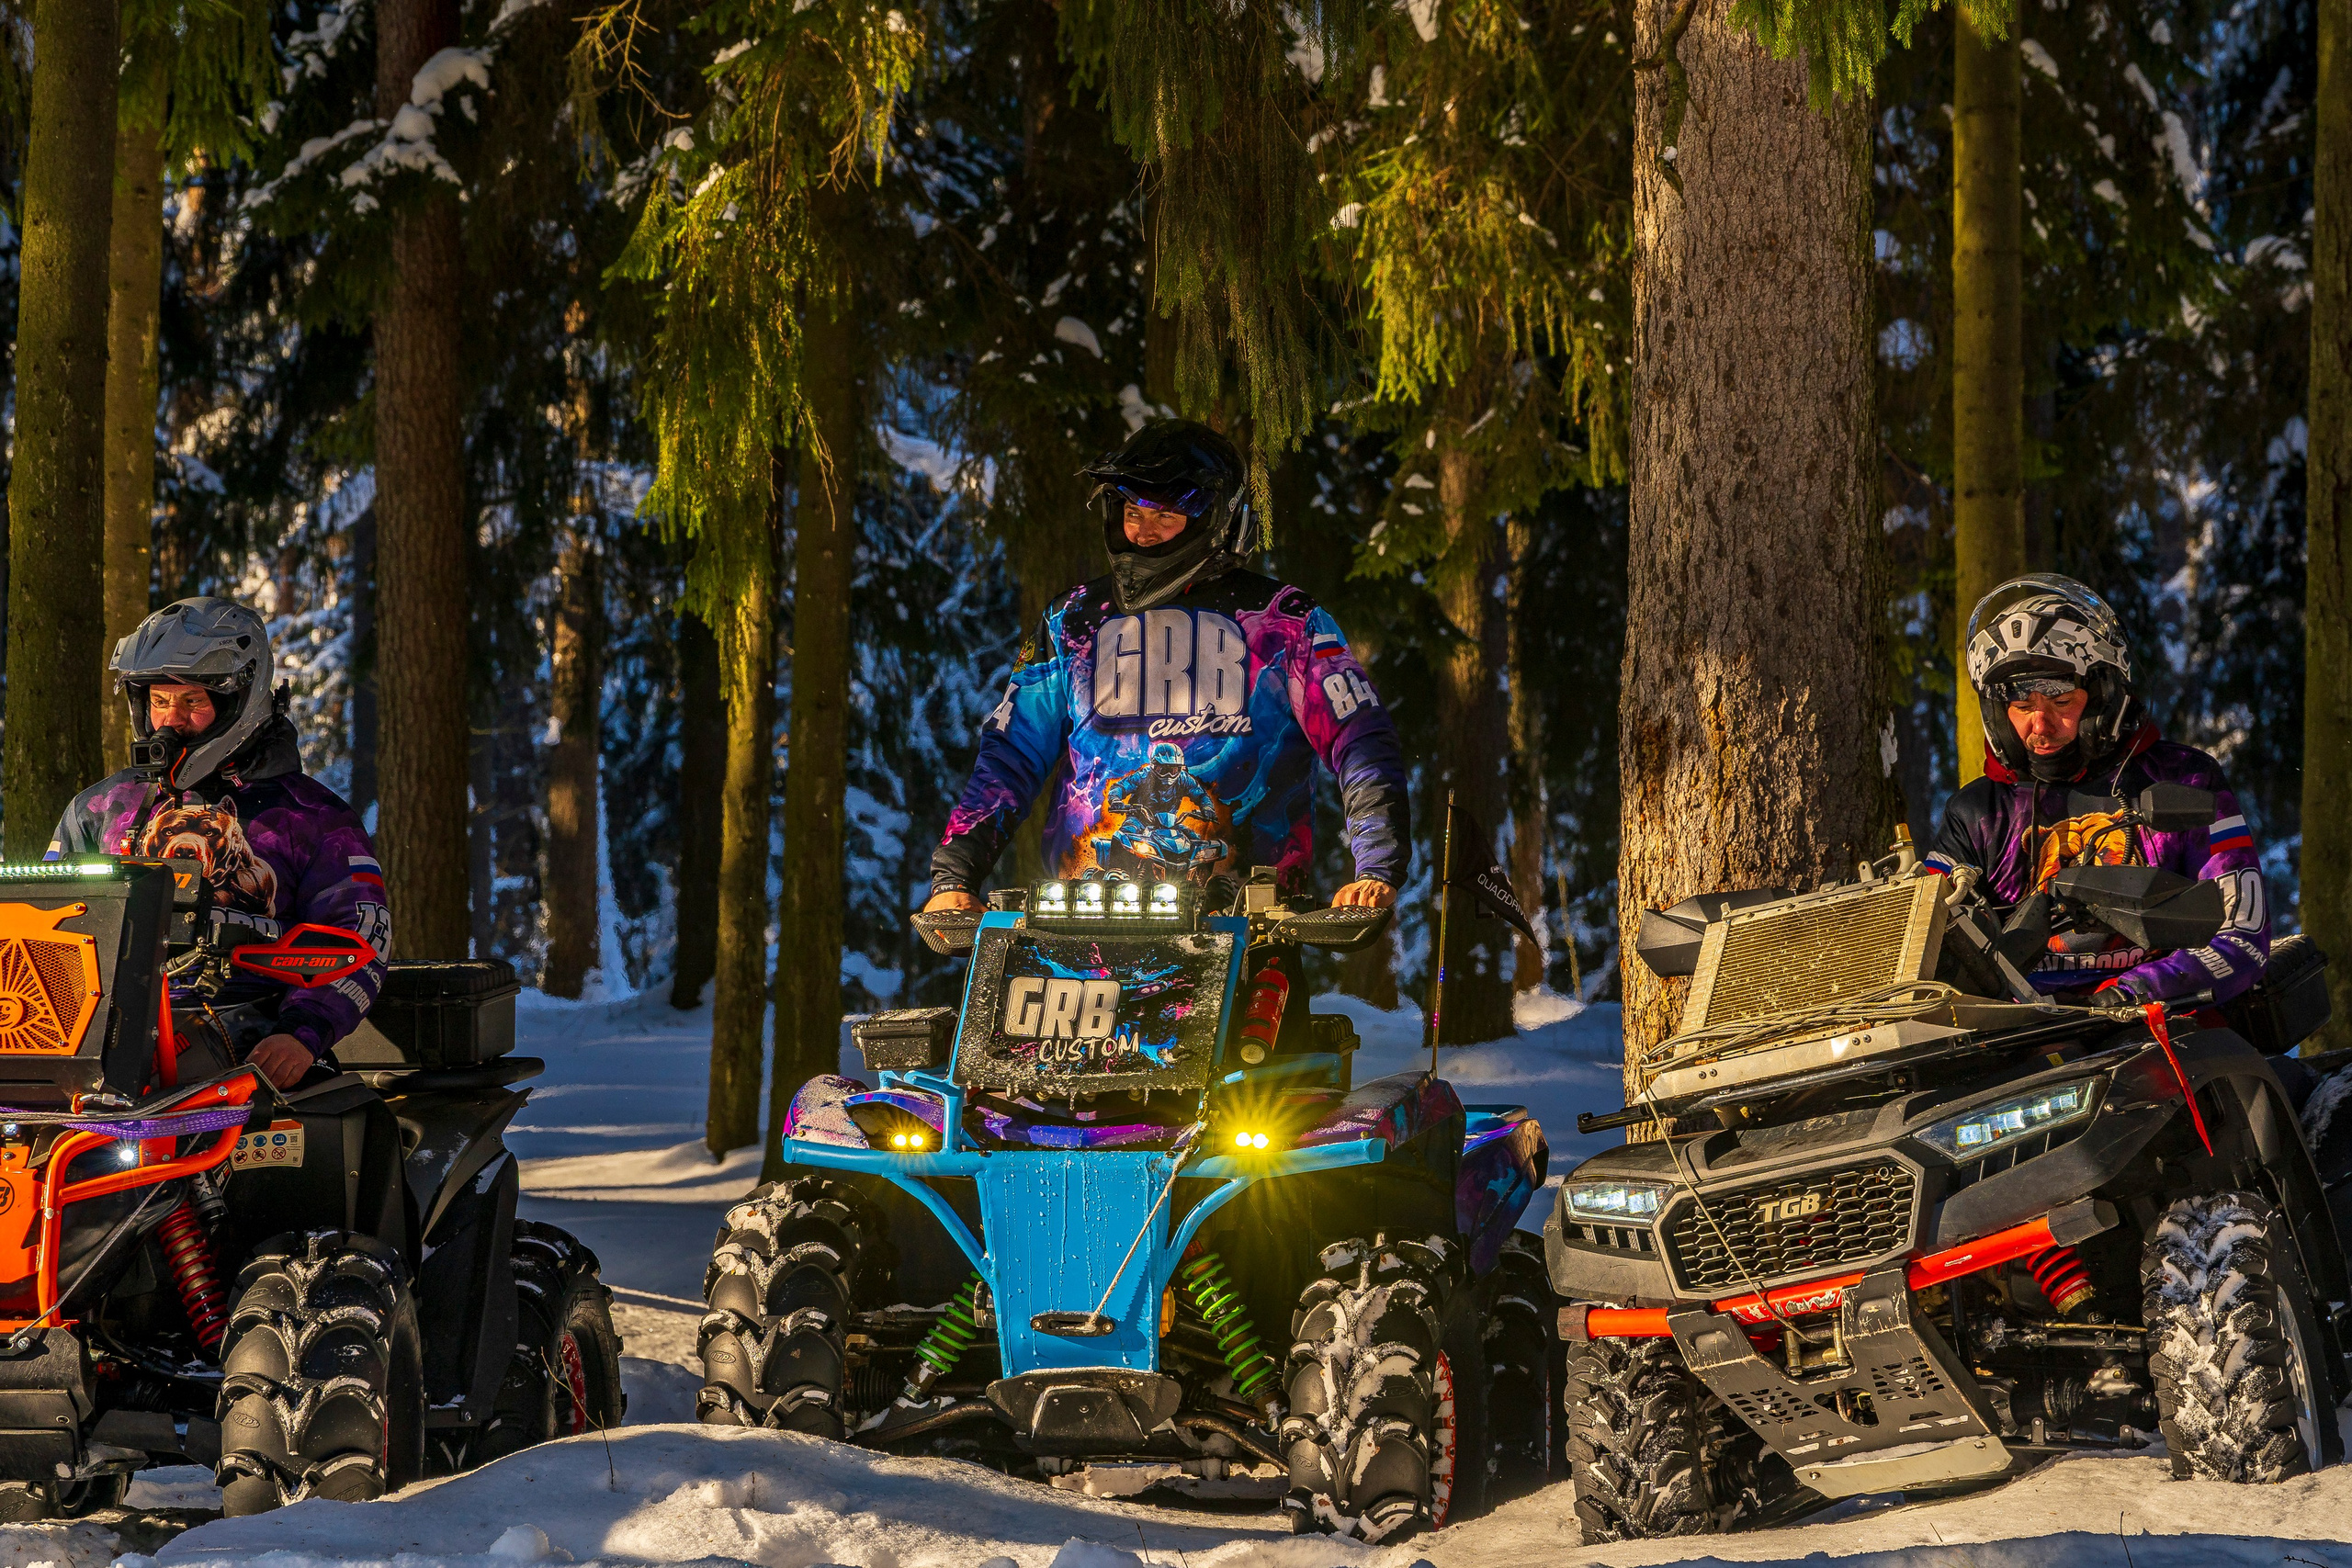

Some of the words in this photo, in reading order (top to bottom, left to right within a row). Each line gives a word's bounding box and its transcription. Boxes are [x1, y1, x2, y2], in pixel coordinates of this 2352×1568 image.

[1092, 608, 1246, 718] GRB
[983, 682, 1019, 732] 4
[1323, 670, 1380, 720] 84
[1148, 704, 1252, 738] custom
[180, 762, 194, 783] AIROH
[2215, 868, 2266, 934] 10
[356, 901, 392, 967] 13
[271, 956, 338, 967] can-am
[1005, 976, 1120, 1039] GRB
[1039, 1032, 1139, 1062] CUSTOM
[1758, 1193, 1820, 1223] TGB
